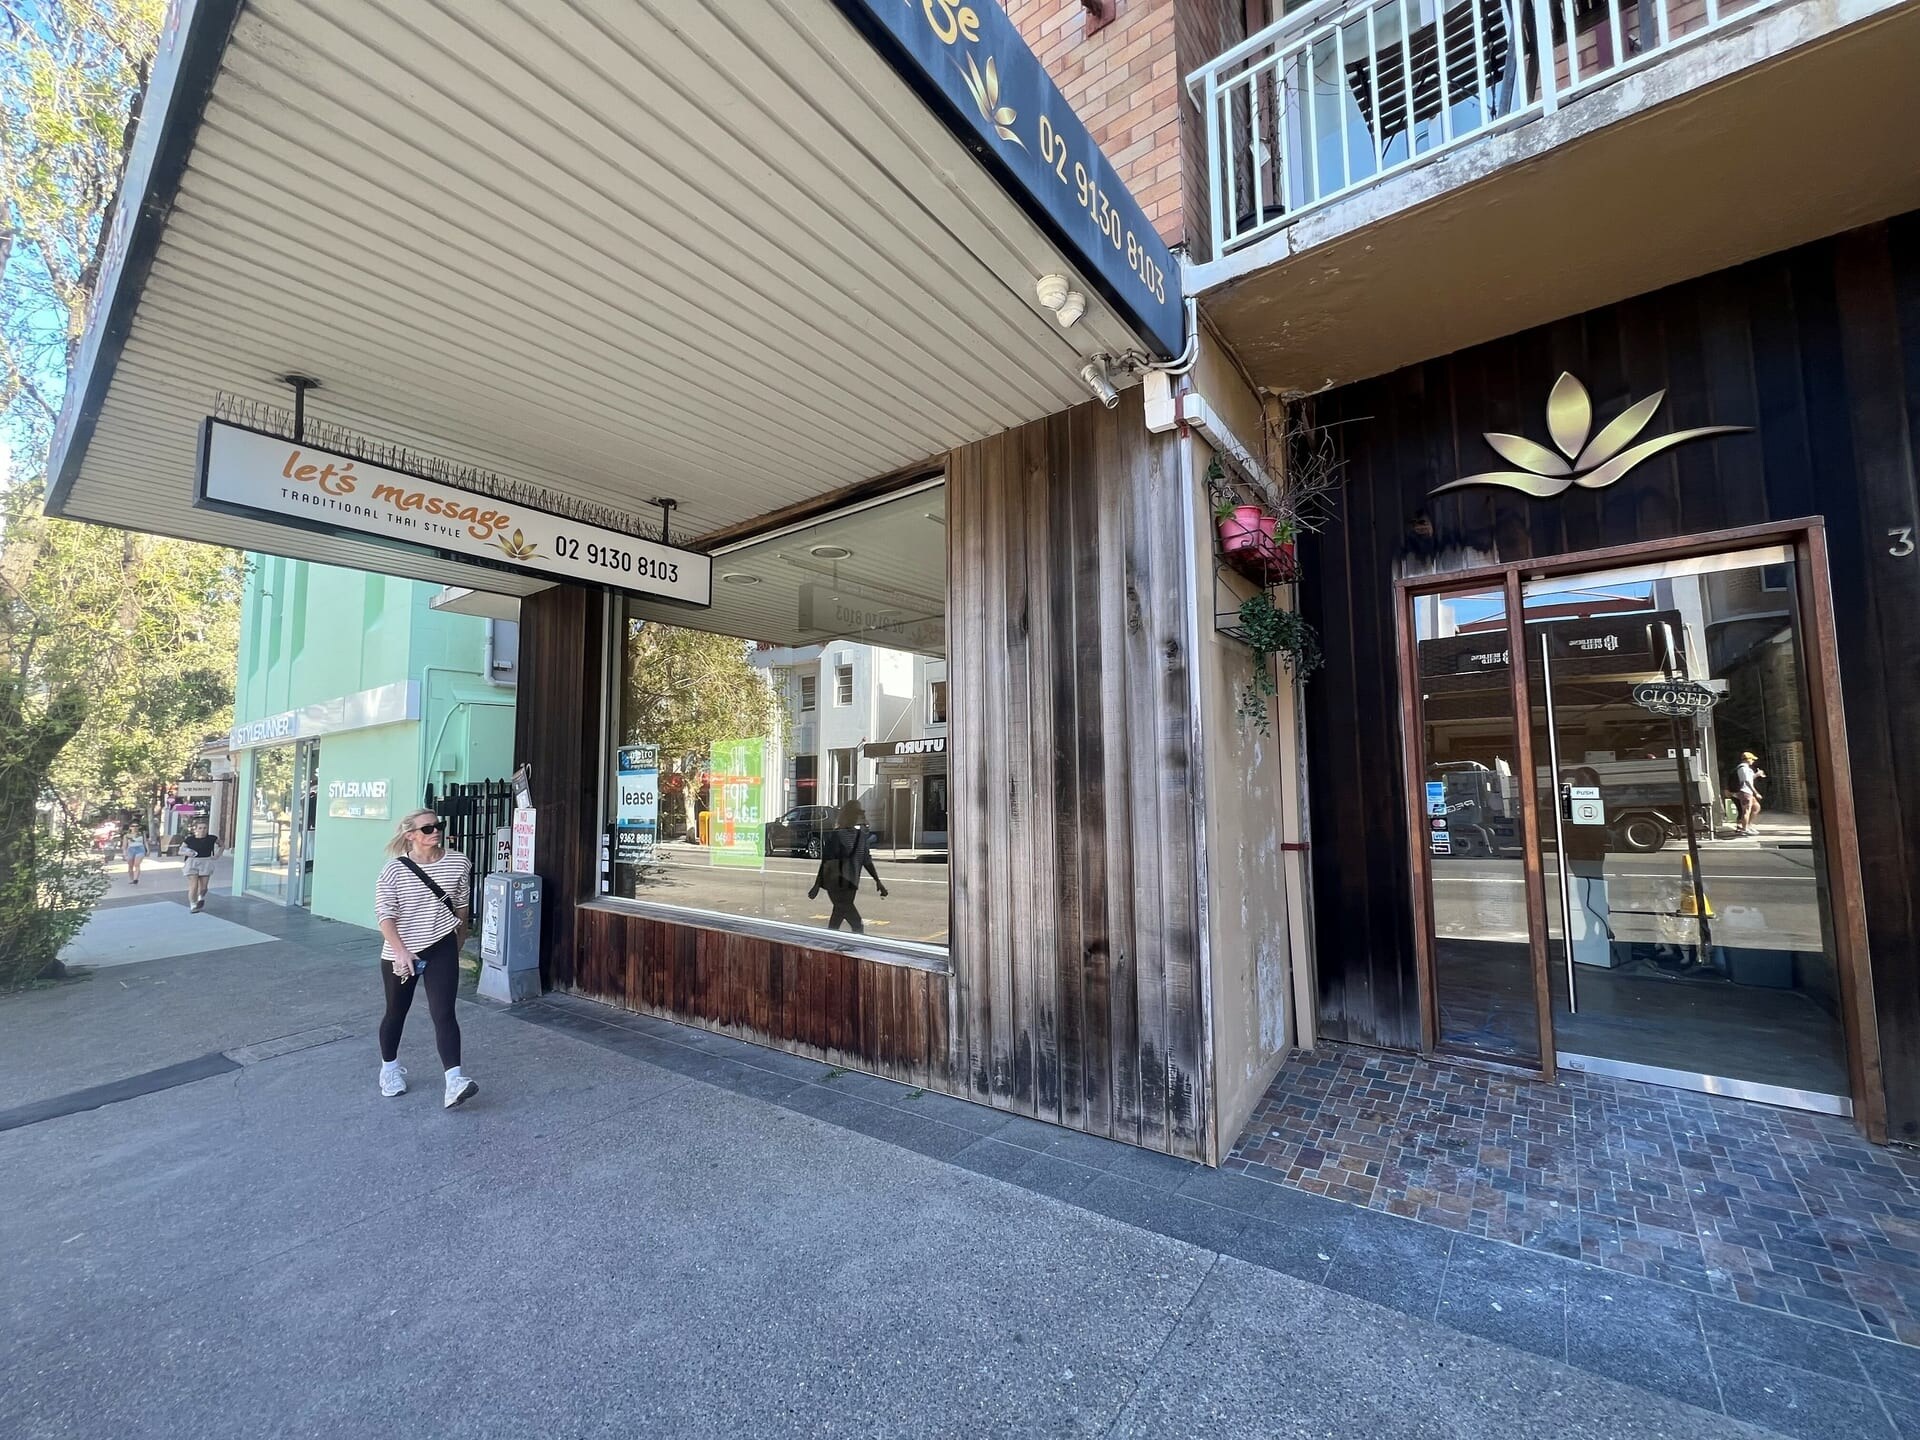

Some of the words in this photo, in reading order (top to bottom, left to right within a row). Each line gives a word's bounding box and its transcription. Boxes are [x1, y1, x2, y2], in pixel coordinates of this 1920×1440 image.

[1039, 115, 1068, 185] 02
[1075, 162, 1122, 250] 9130
[1127, 231, 1166, 305] 8103
[282, 450, 358, 496] let's
[372, 483, 511, 541] massage
[281, 488, 379, 520] TRADITIONAL
[387, 513, 417, 529] THAI
[424, 522, 461, 538] STYLE
[1888, 527, 1915, 557] 3
[555, 535, 579, 560] 02
[587, 543, 631, 572] 9130
[638, 556, 678, 582] 8103
[1640, 689, 1712, 707] CLOSED
[237, 717, 289, 744] STYLERUNNER
[329, 781, 386, 798] STYLERUNNER
[622, 785, 654, 806] lease
[514, 824, 534, 834] PARKING
[619, 832, 635, 844] 9362
